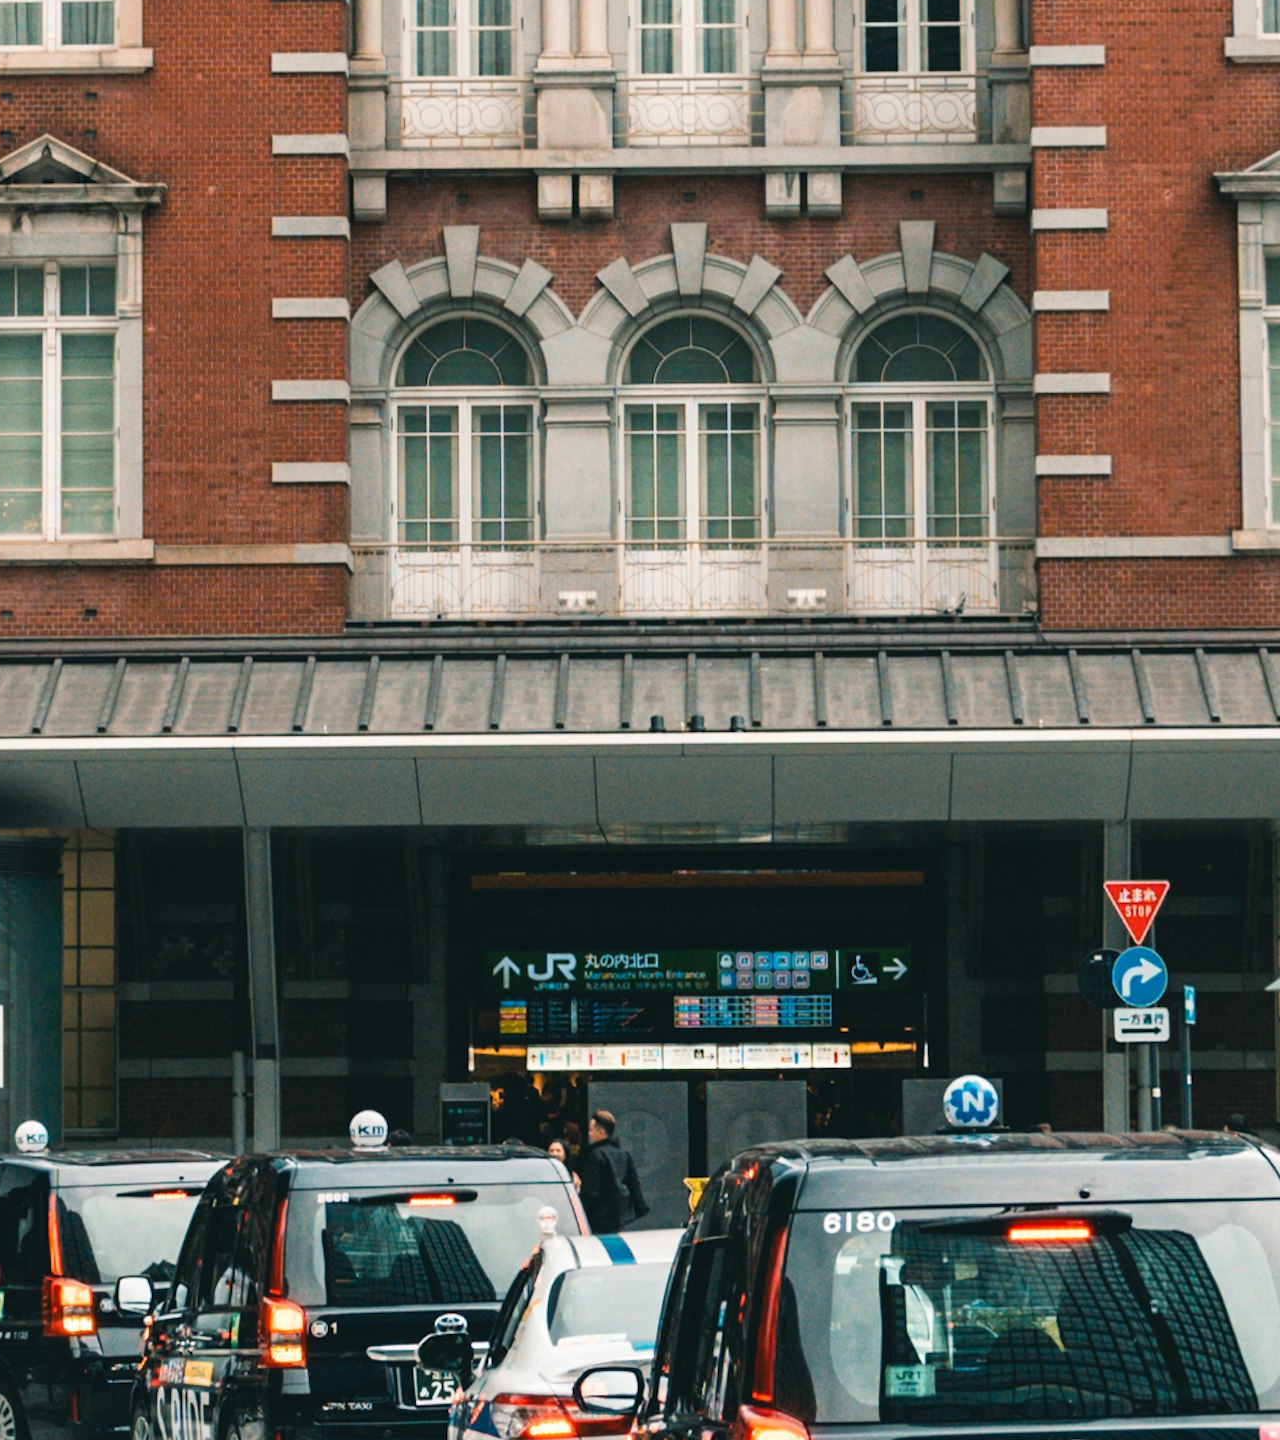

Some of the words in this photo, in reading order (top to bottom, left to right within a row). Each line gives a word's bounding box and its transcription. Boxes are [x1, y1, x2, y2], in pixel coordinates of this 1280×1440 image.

[1117, 887, 1158, 903] 止まれ
[1124, 904, 1153, 918] STOP
[527, 953, 577, 981] JR
[584, 953, 659, 969] 丸の内北口
[583, 970, 636, 980] Marunouchi
[638, 970, 664, 980] North
[665, 970, 707, 980] Entrance
[1119, 1013, 1165, 1026] 一方通行
[961, 1091, 985, 1112] N
[822, 1210, 896, 1235] 6180
